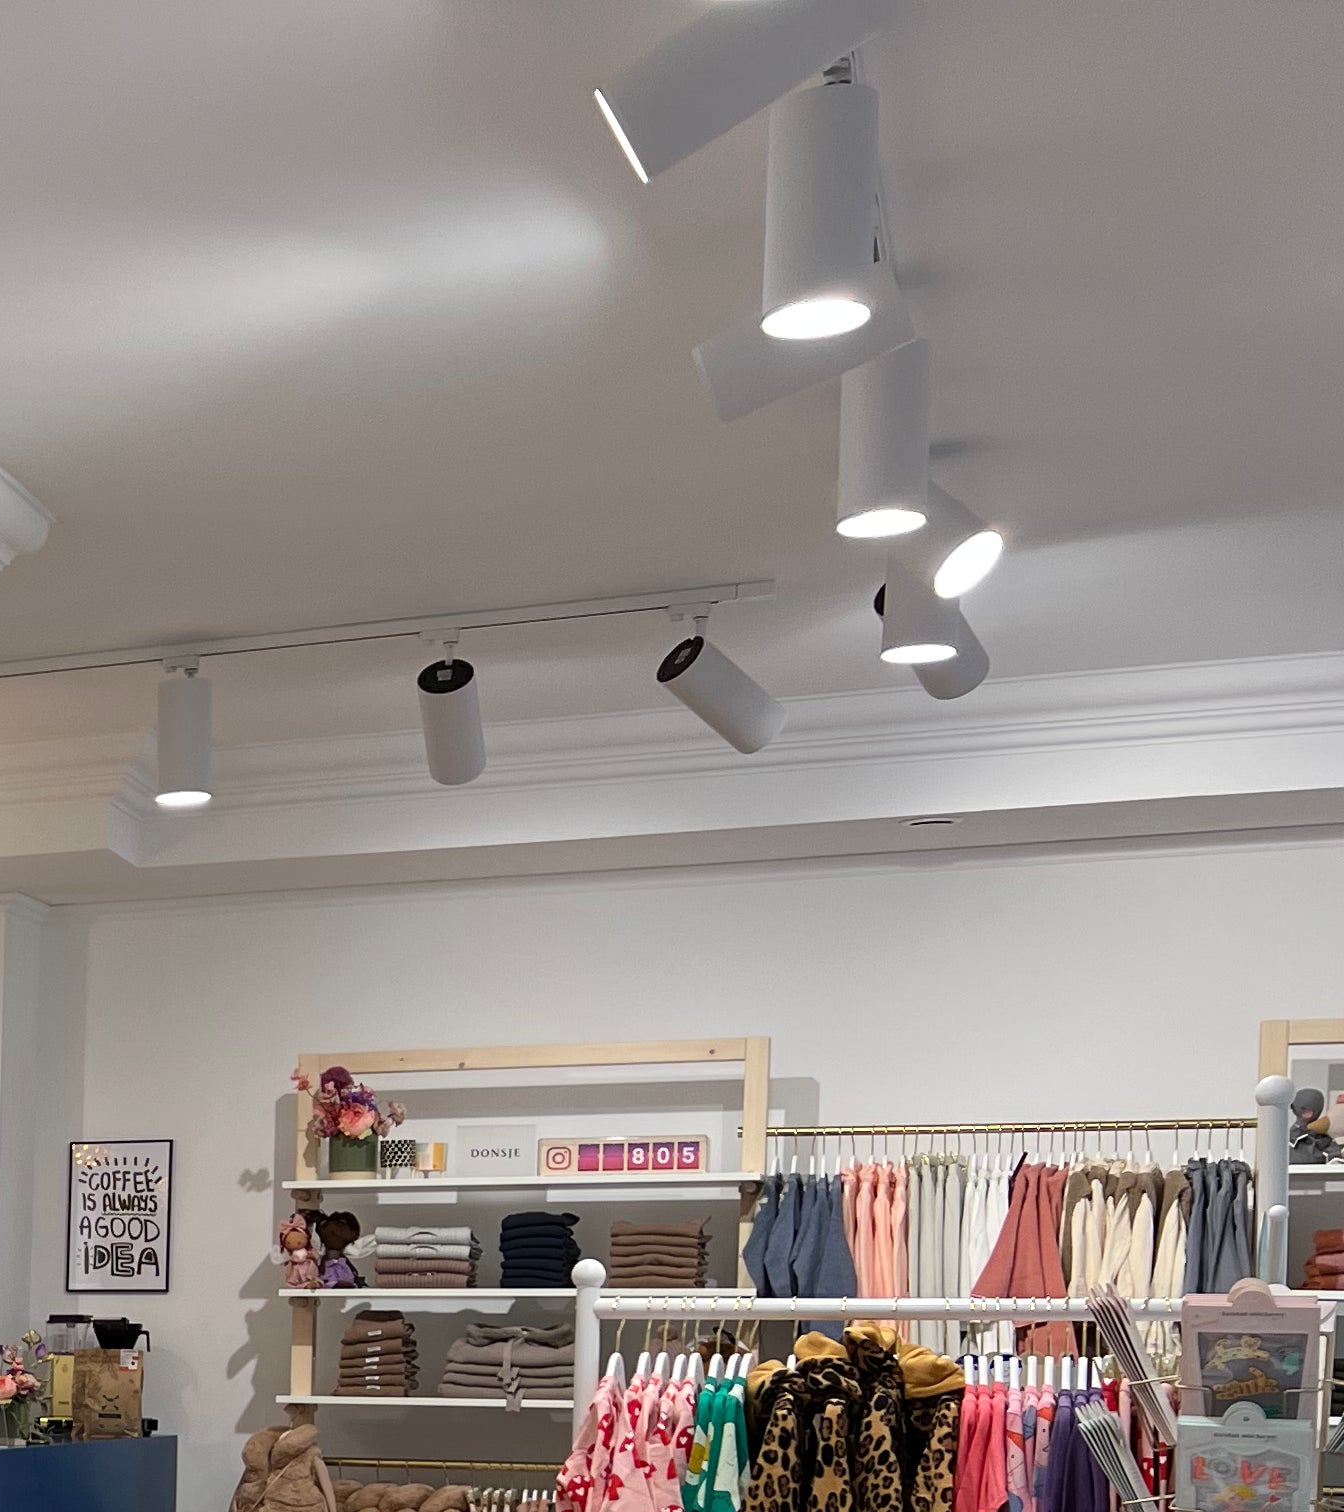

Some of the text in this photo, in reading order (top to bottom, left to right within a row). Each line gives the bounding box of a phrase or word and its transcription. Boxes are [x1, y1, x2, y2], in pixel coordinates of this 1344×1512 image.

[470, 1148, 521, 1159] DONSJE
[88, 1169, 155, 1193] COFFEE
[81, 1192, 158, 1213] IS ALWAYS
[79, 1216, 160, 1243] A GOOD
